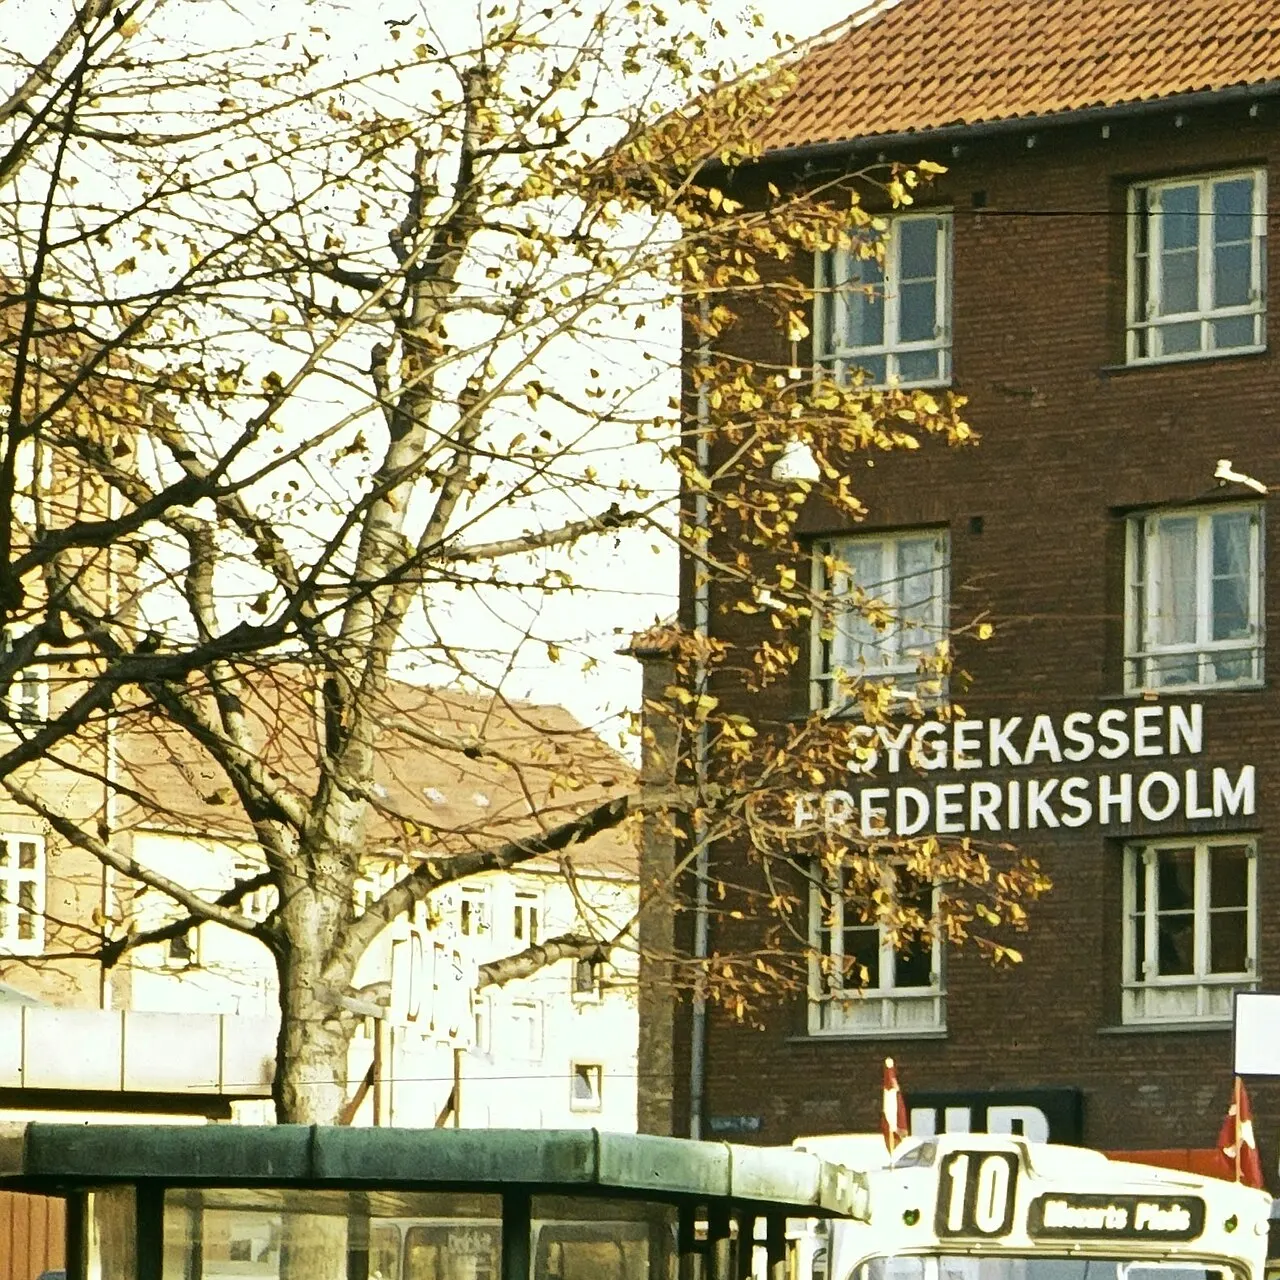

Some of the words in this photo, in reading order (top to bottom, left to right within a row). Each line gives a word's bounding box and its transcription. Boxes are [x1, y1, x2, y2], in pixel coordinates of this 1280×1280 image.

[845, 703, 1204, 774] SYGEKASSEN
[793, 764, 1256, 837] FREDERIKSHOLM
[946, 1153, 1010, 1232] 10
